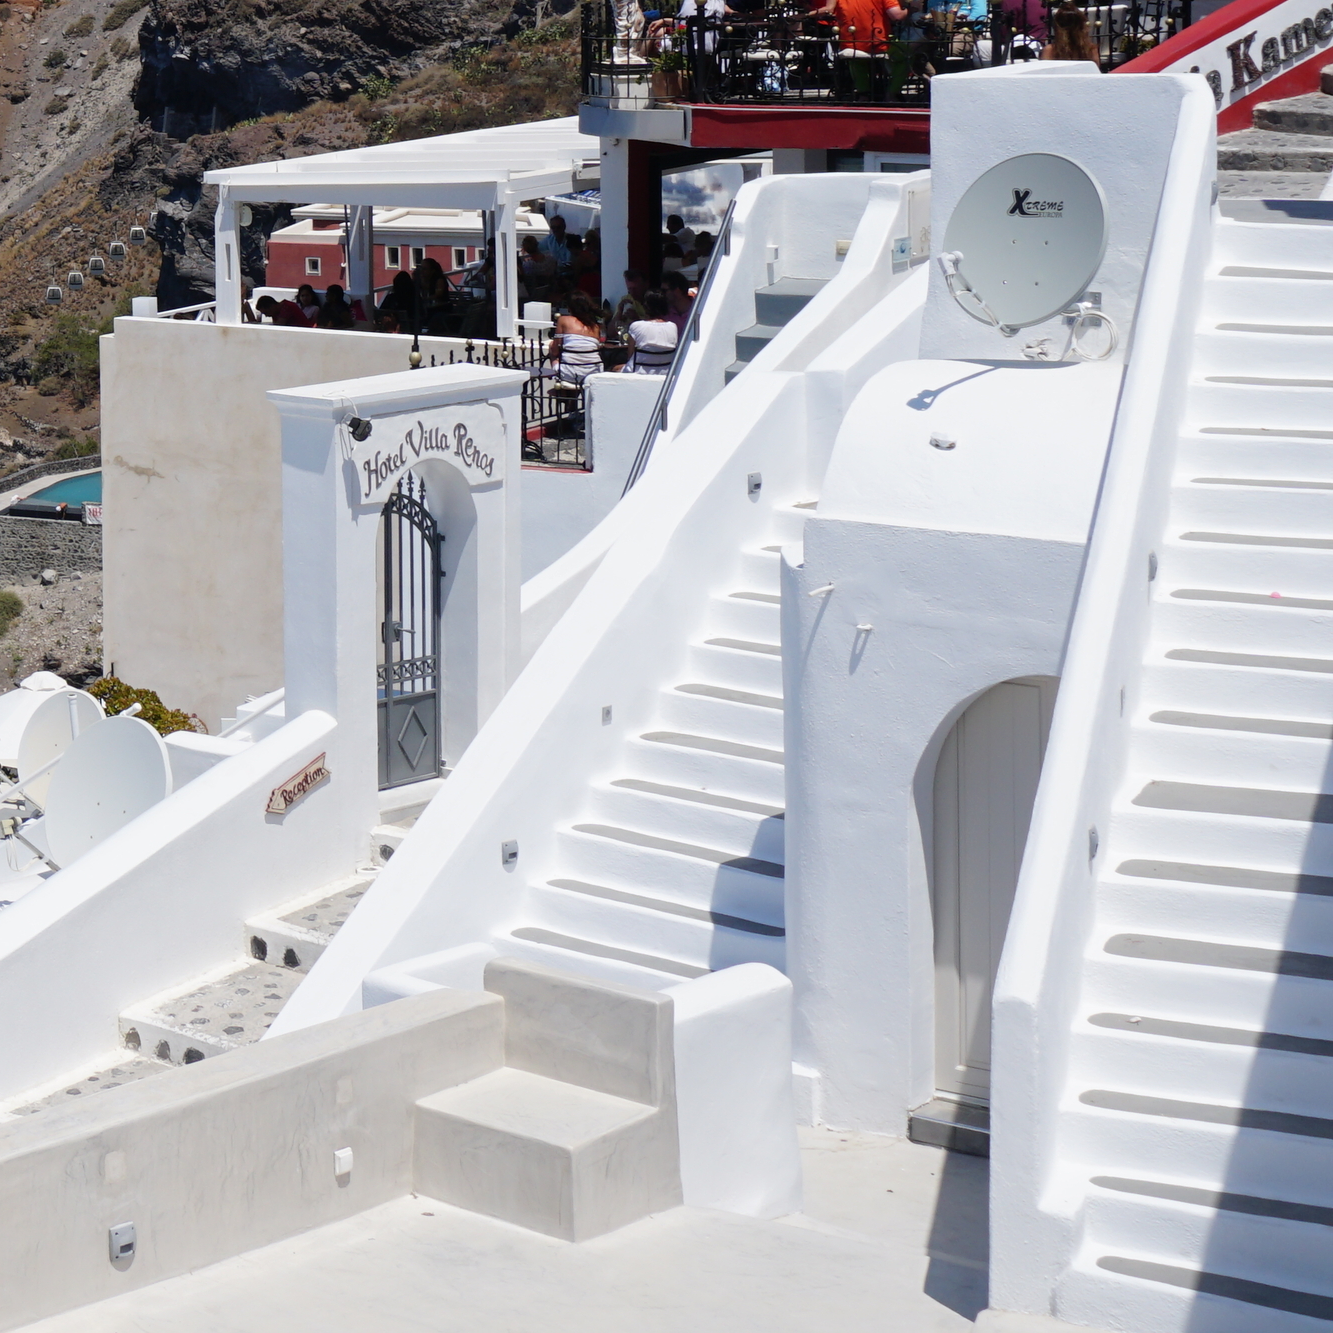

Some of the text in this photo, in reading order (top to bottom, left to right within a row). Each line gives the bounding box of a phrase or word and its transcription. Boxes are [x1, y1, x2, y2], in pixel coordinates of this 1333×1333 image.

[1226, 4, 1333, 92] Kame
[363, 420, 494, 498] Hotel Villa Renos
[280, 767, 324, 808] Reception
